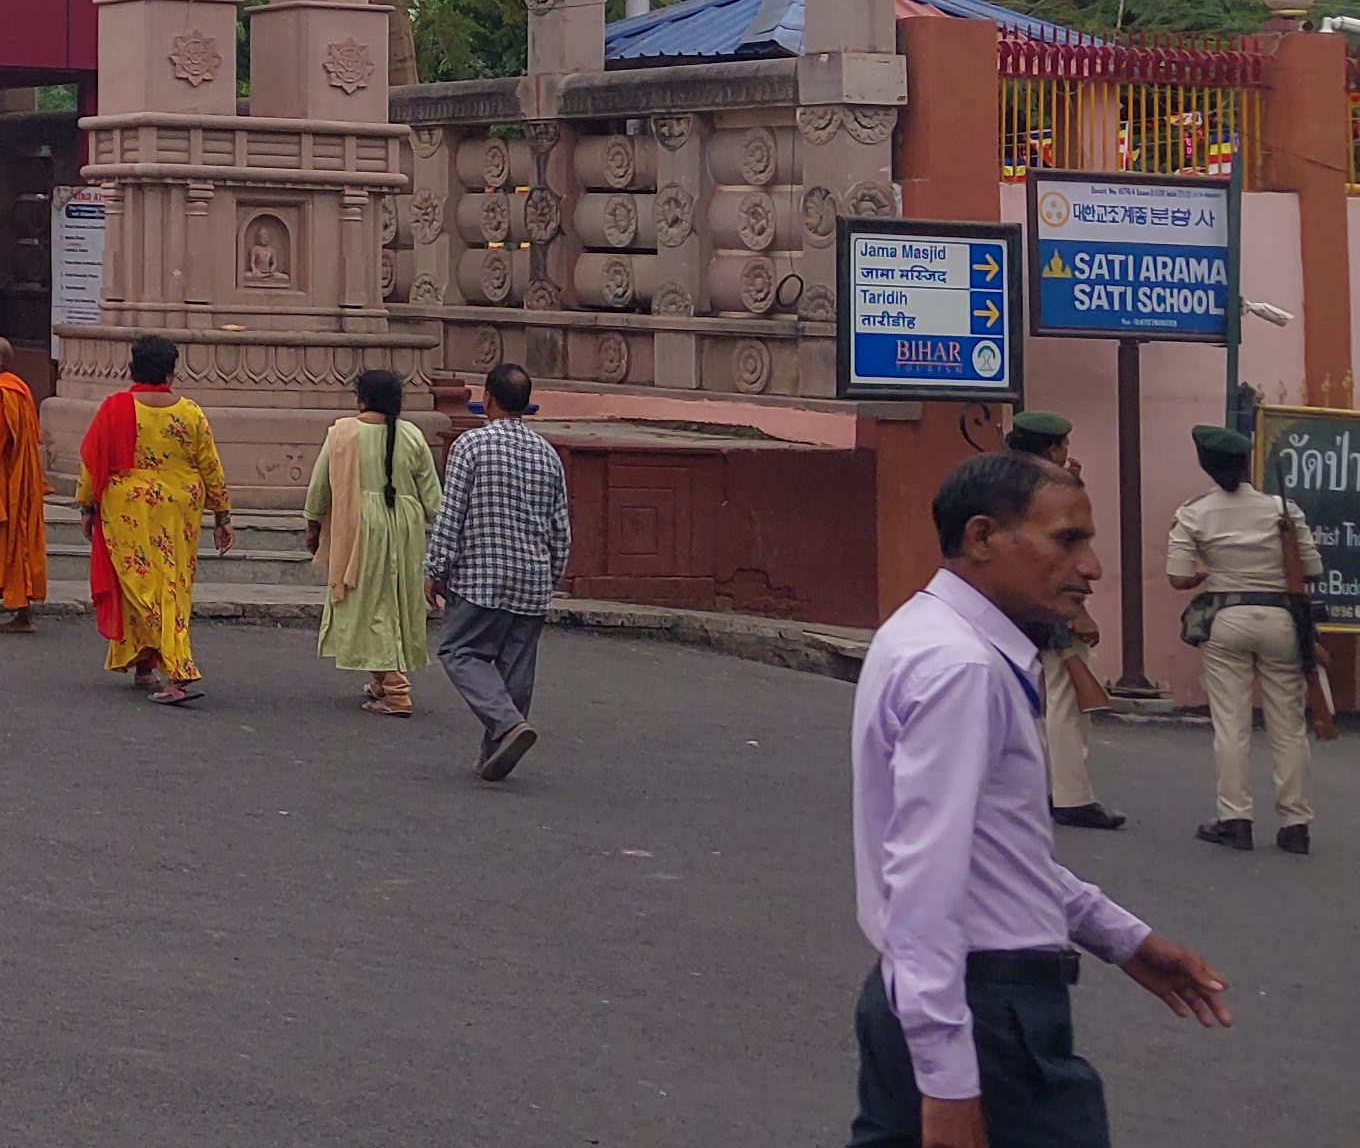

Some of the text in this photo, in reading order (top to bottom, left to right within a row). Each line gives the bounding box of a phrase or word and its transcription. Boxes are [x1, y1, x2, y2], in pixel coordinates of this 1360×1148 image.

[860, 243, 947, 263] Jama Masjid
[860, 265, 948, 283] जामा मस्जिद
[1073, 252, 1228, 286] SATI ARAMA
[860, 289, 908, 306] Taridih
[1073, 284, 1225, 316] SATI SCHOOL
[860, 310, 917, 329] तारीडीह
[895, 339, 961, 362] BIHAR
